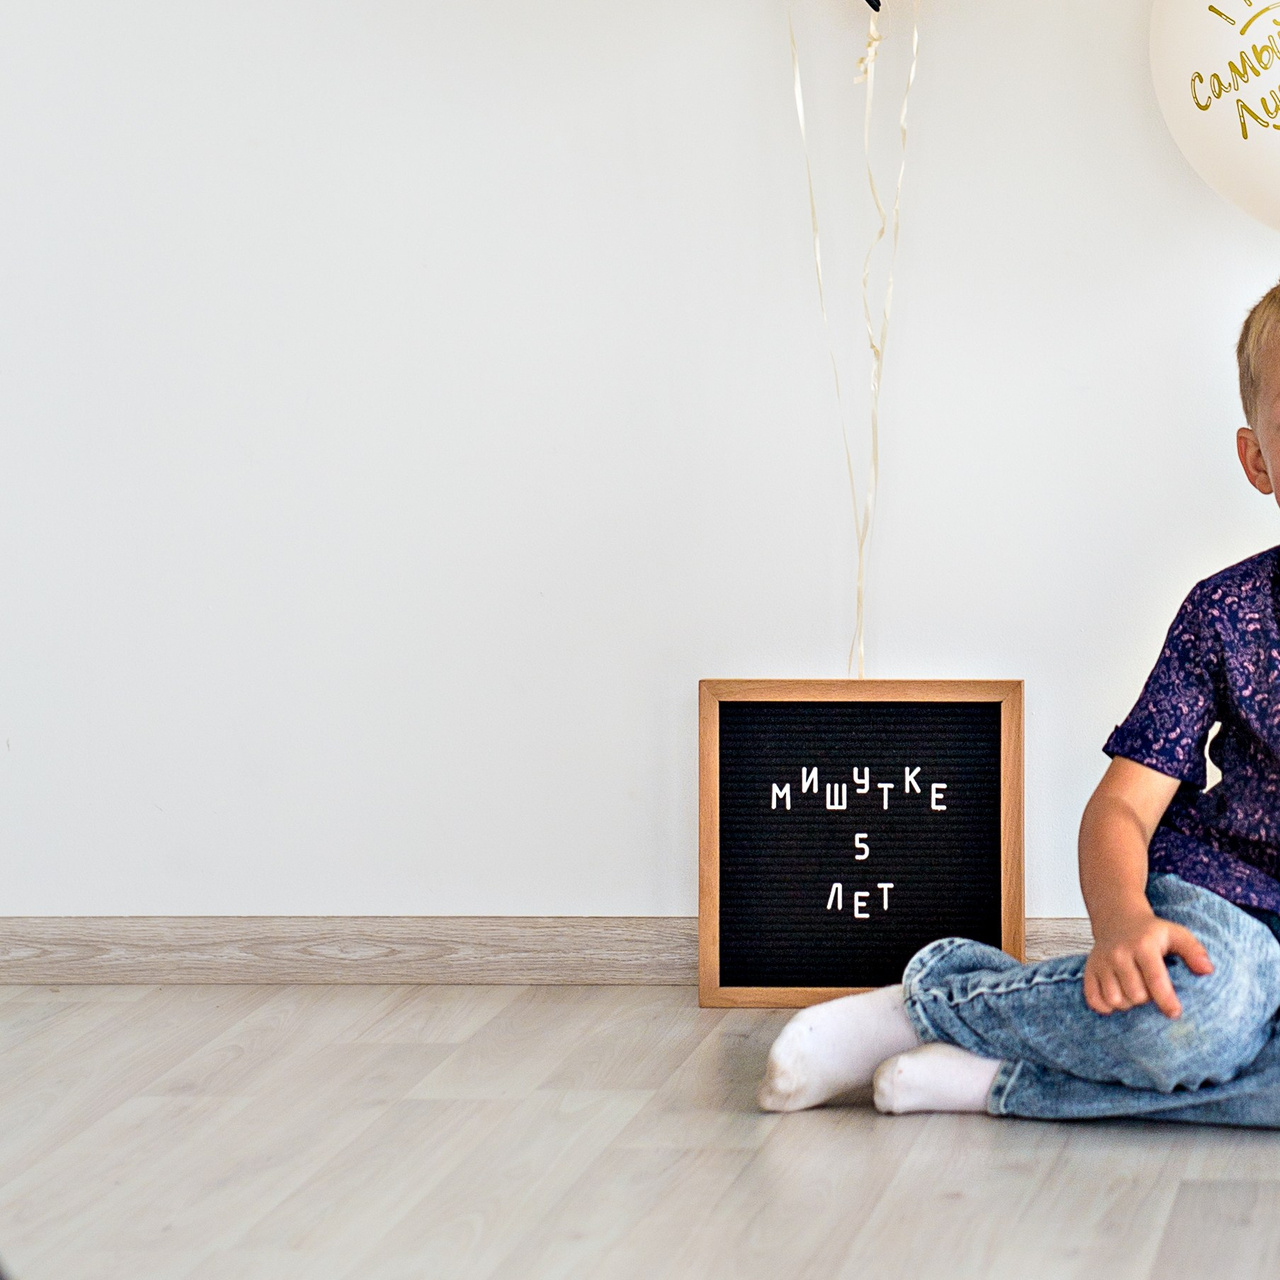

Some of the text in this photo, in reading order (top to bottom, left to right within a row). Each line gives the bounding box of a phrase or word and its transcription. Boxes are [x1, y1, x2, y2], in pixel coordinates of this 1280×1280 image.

[771, 766, 947, 811] МИШУТКЕ
[854, 832, 870, 860] 5
[826, 883, 894, 918] ЛЕТ
